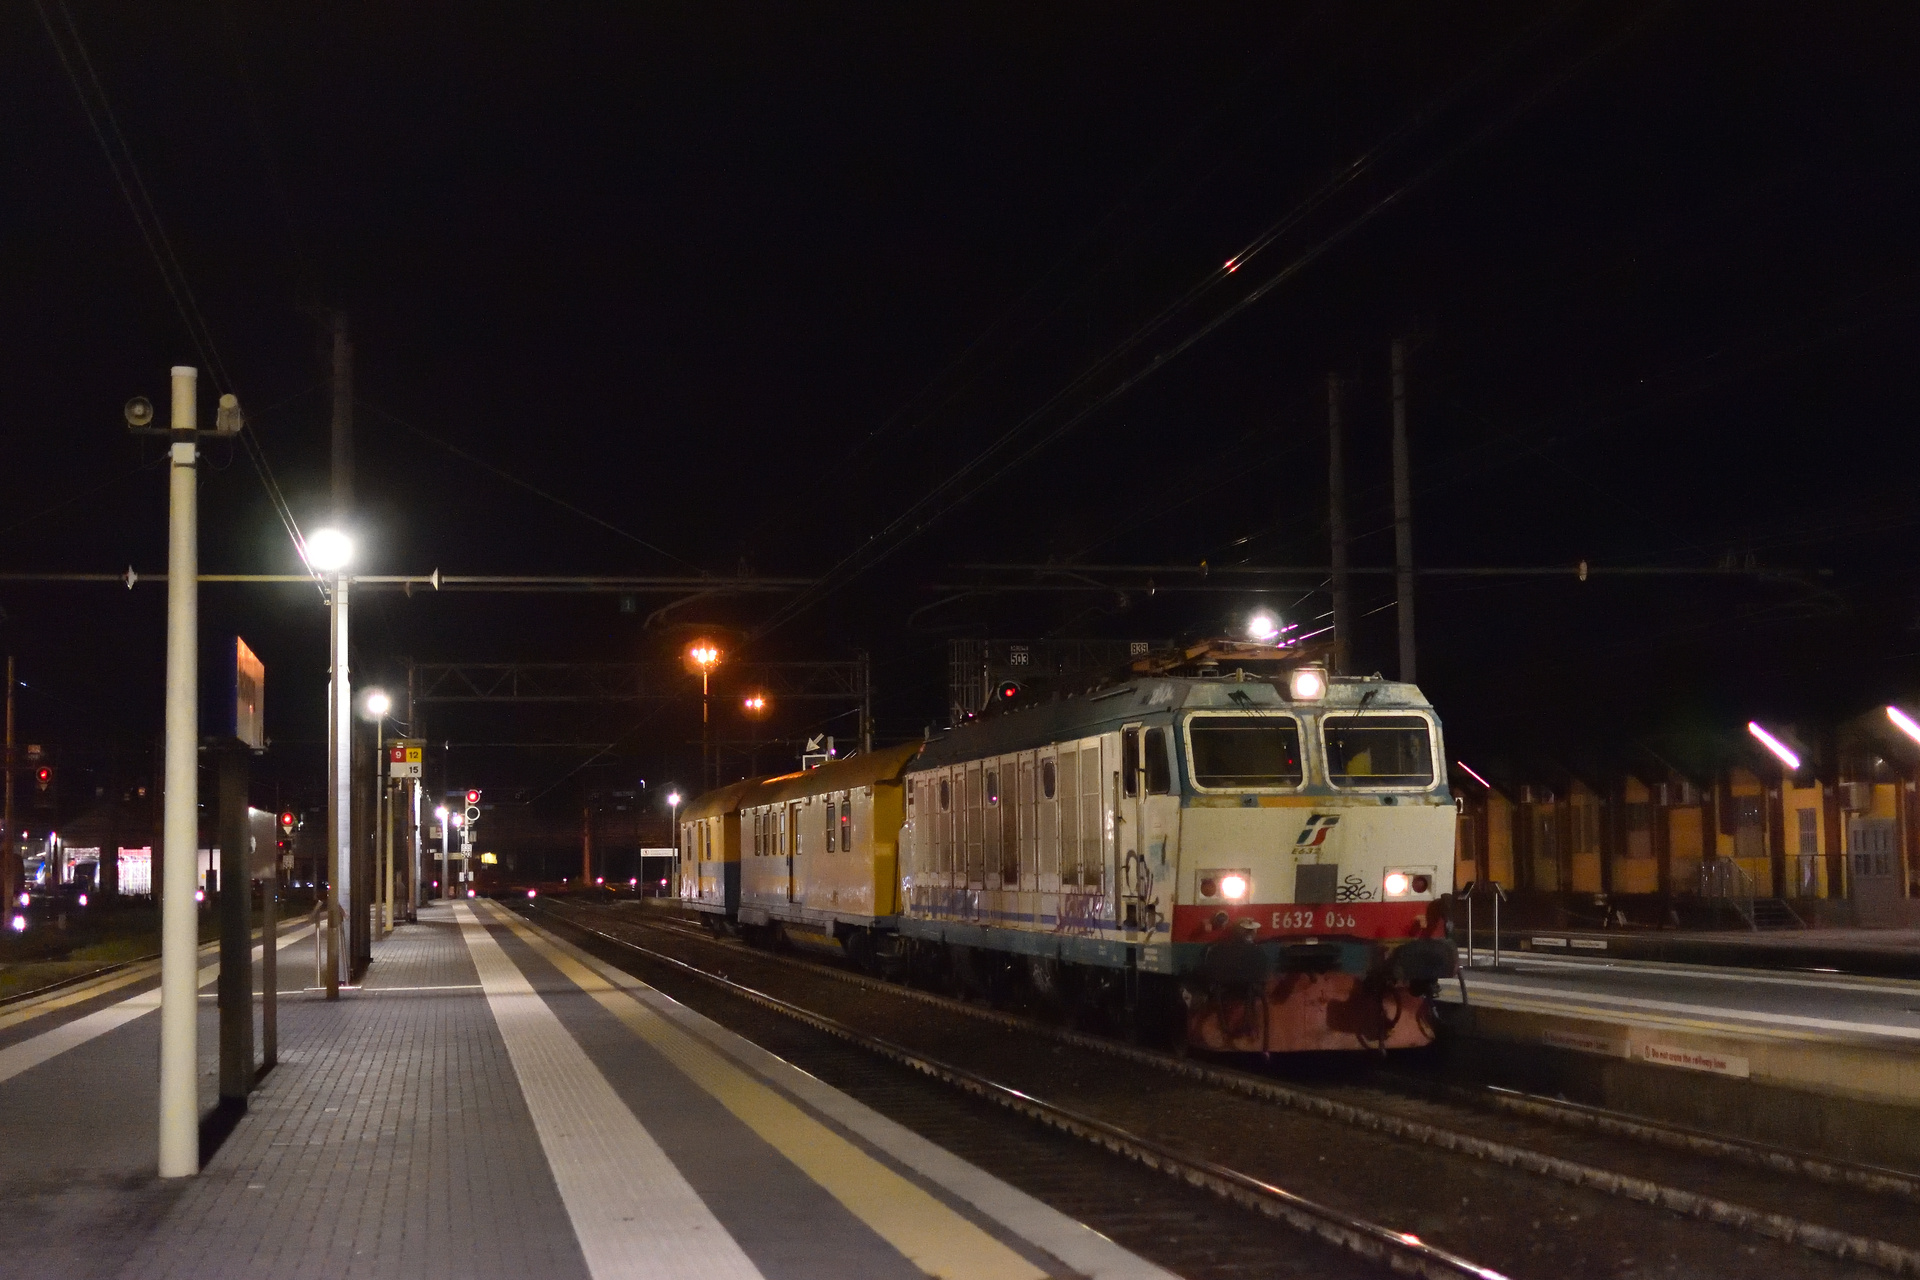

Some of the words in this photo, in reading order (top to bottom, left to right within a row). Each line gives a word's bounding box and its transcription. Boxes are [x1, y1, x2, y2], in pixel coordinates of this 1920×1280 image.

[1012, 654, 1028, 665] 503
[395, 751, 402, 759] 9
[409, 751, 419, 759] 12
[409, 766, 419, 774] 15
[1271, 911, 1314, 929] E632
